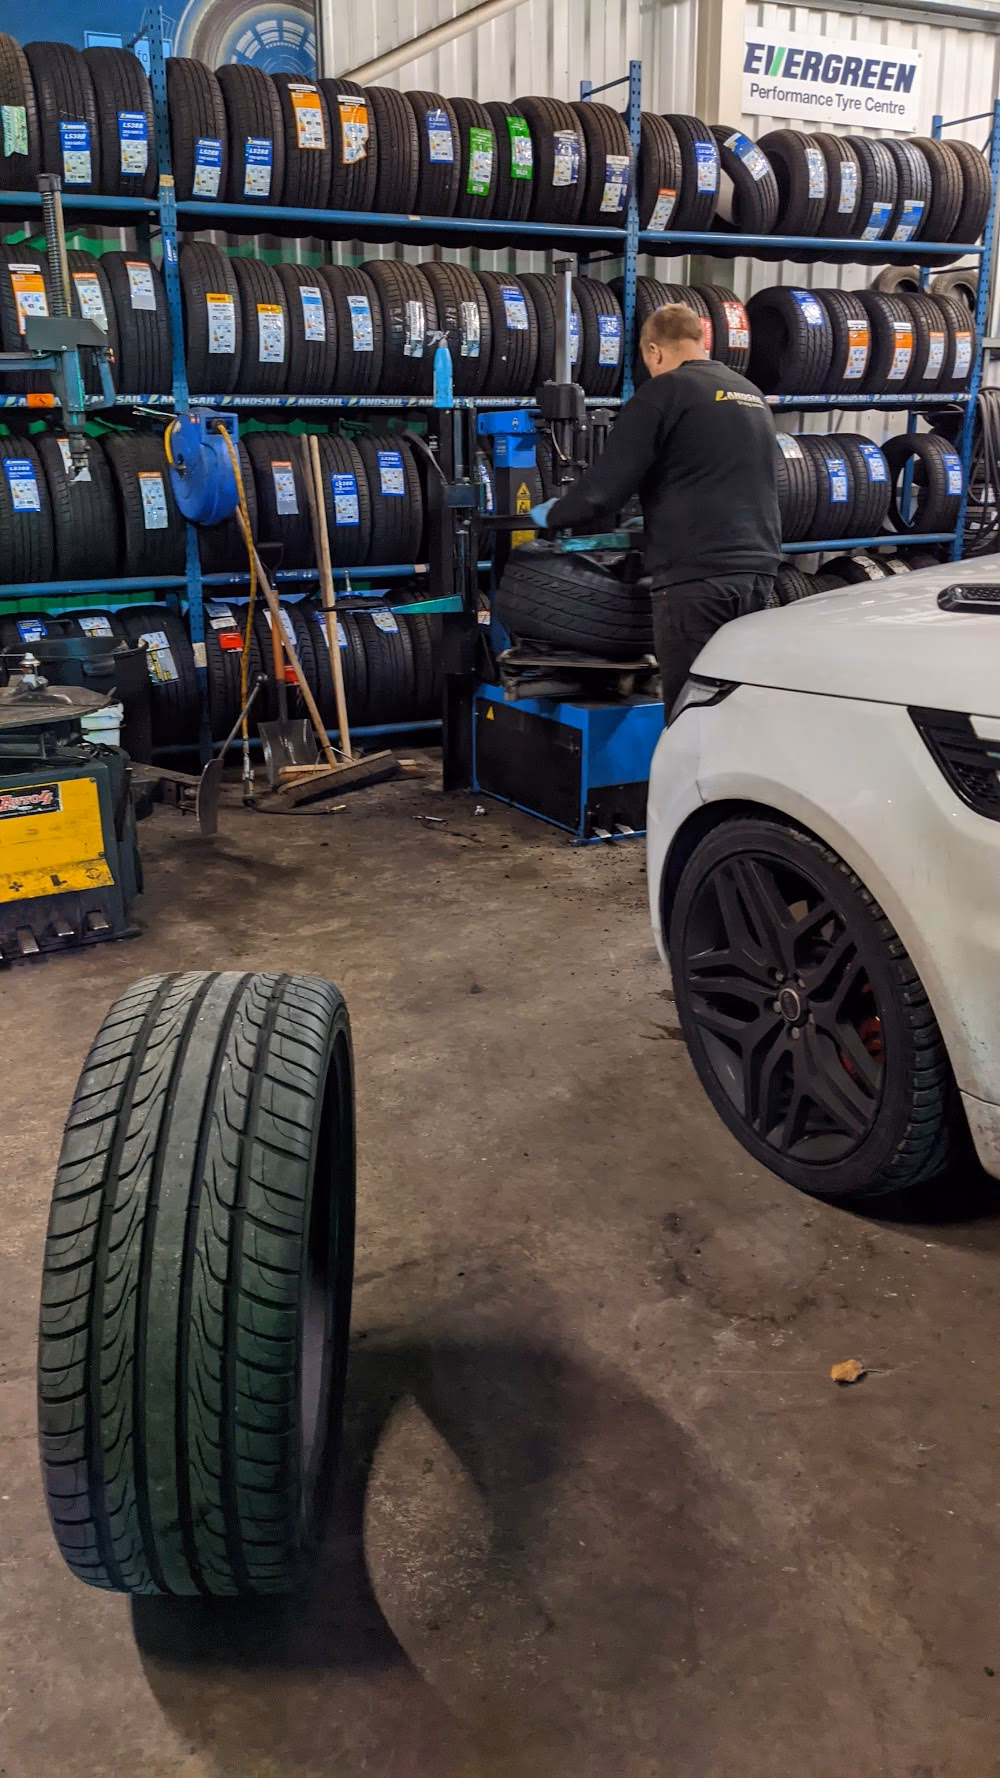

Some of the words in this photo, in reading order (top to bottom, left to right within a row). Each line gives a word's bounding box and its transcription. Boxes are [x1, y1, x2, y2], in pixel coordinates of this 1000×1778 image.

[743, 42, 917, 94] EVERGREEN
[750, 82, 833, 107] Performance
[835, 93, 862, 111] Tyre
[865, 97, 905, 115] Centre
[221, 395, 282, 406] LANDSAIL
[284, 396, 344, 407] LANDSAIL
[347, 397, 404, 407] LANDSAIL
